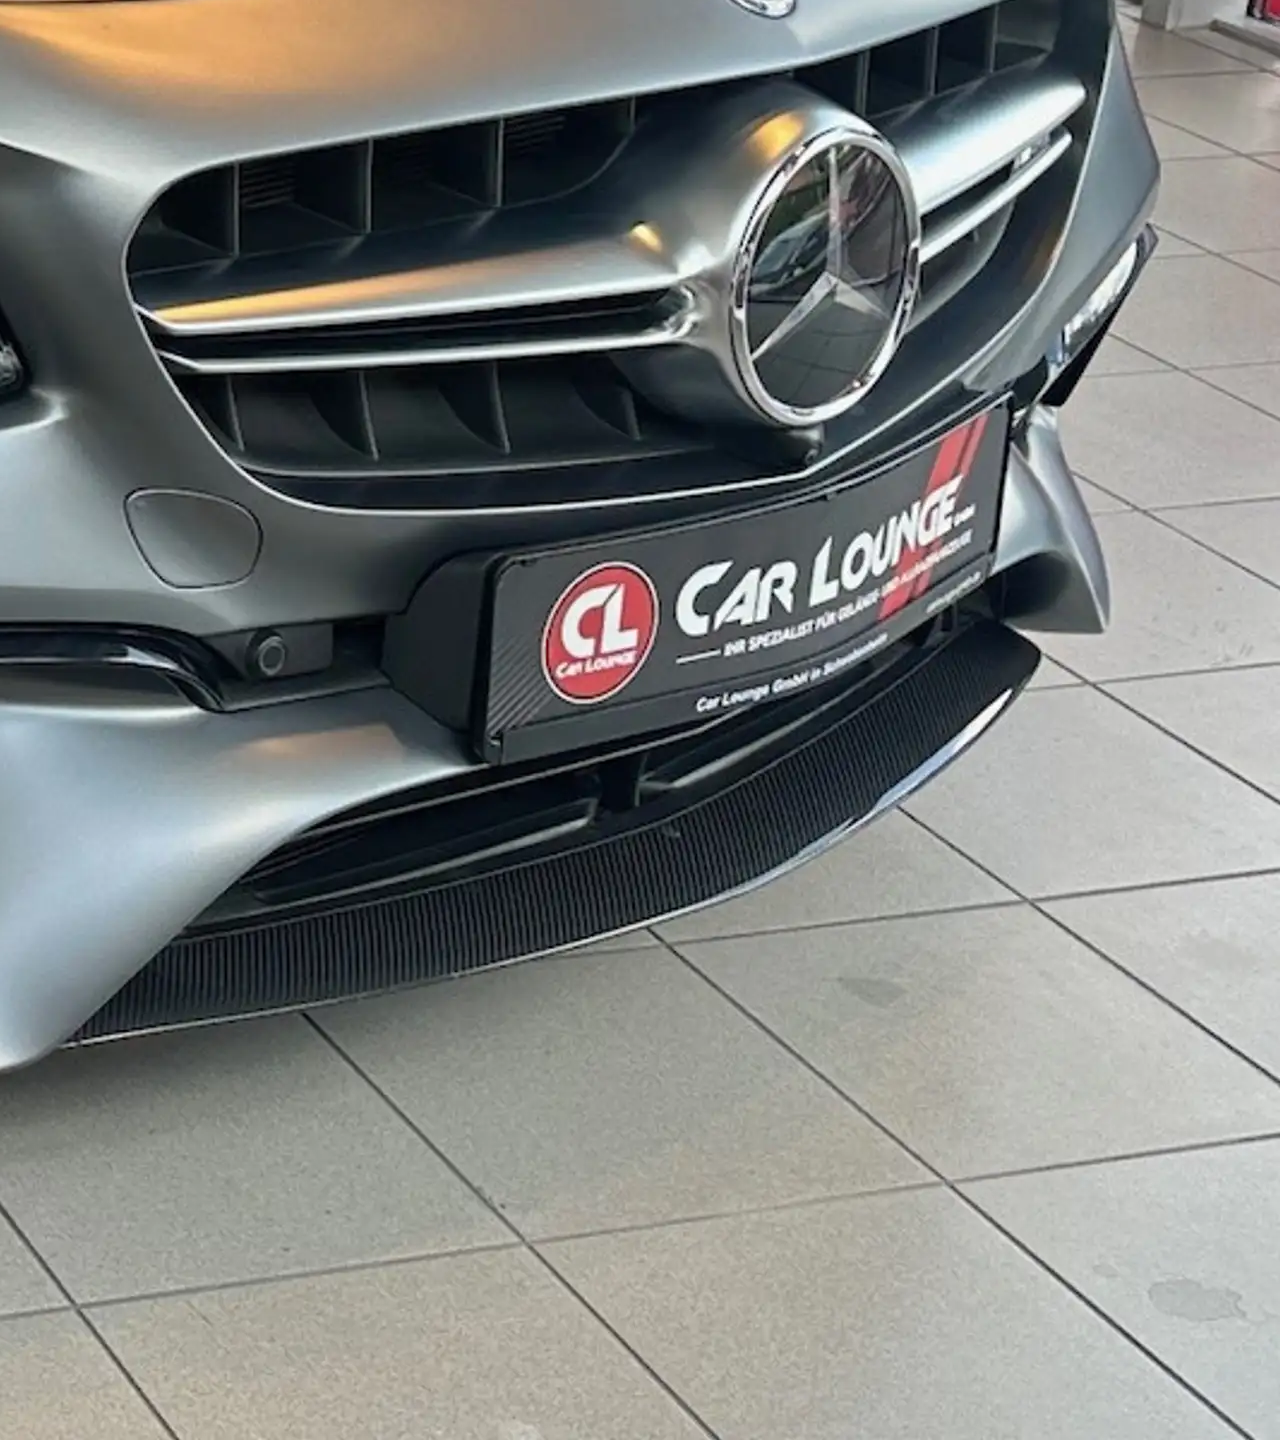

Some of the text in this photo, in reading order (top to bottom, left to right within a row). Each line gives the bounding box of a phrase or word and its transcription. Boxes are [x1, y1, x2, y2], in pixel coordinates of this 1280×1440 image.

[676, 560, 797, 637] CAR
[808, 473, 964, 607] LOUNGE
[561, 583, 639, 658] CL
[747, 618, 815, 652] SPEZIALIST
[695, 695, 721, 713] Car
[721, 683, 770, 707] Lounge
[771, 668, 810, 694] GmbH
